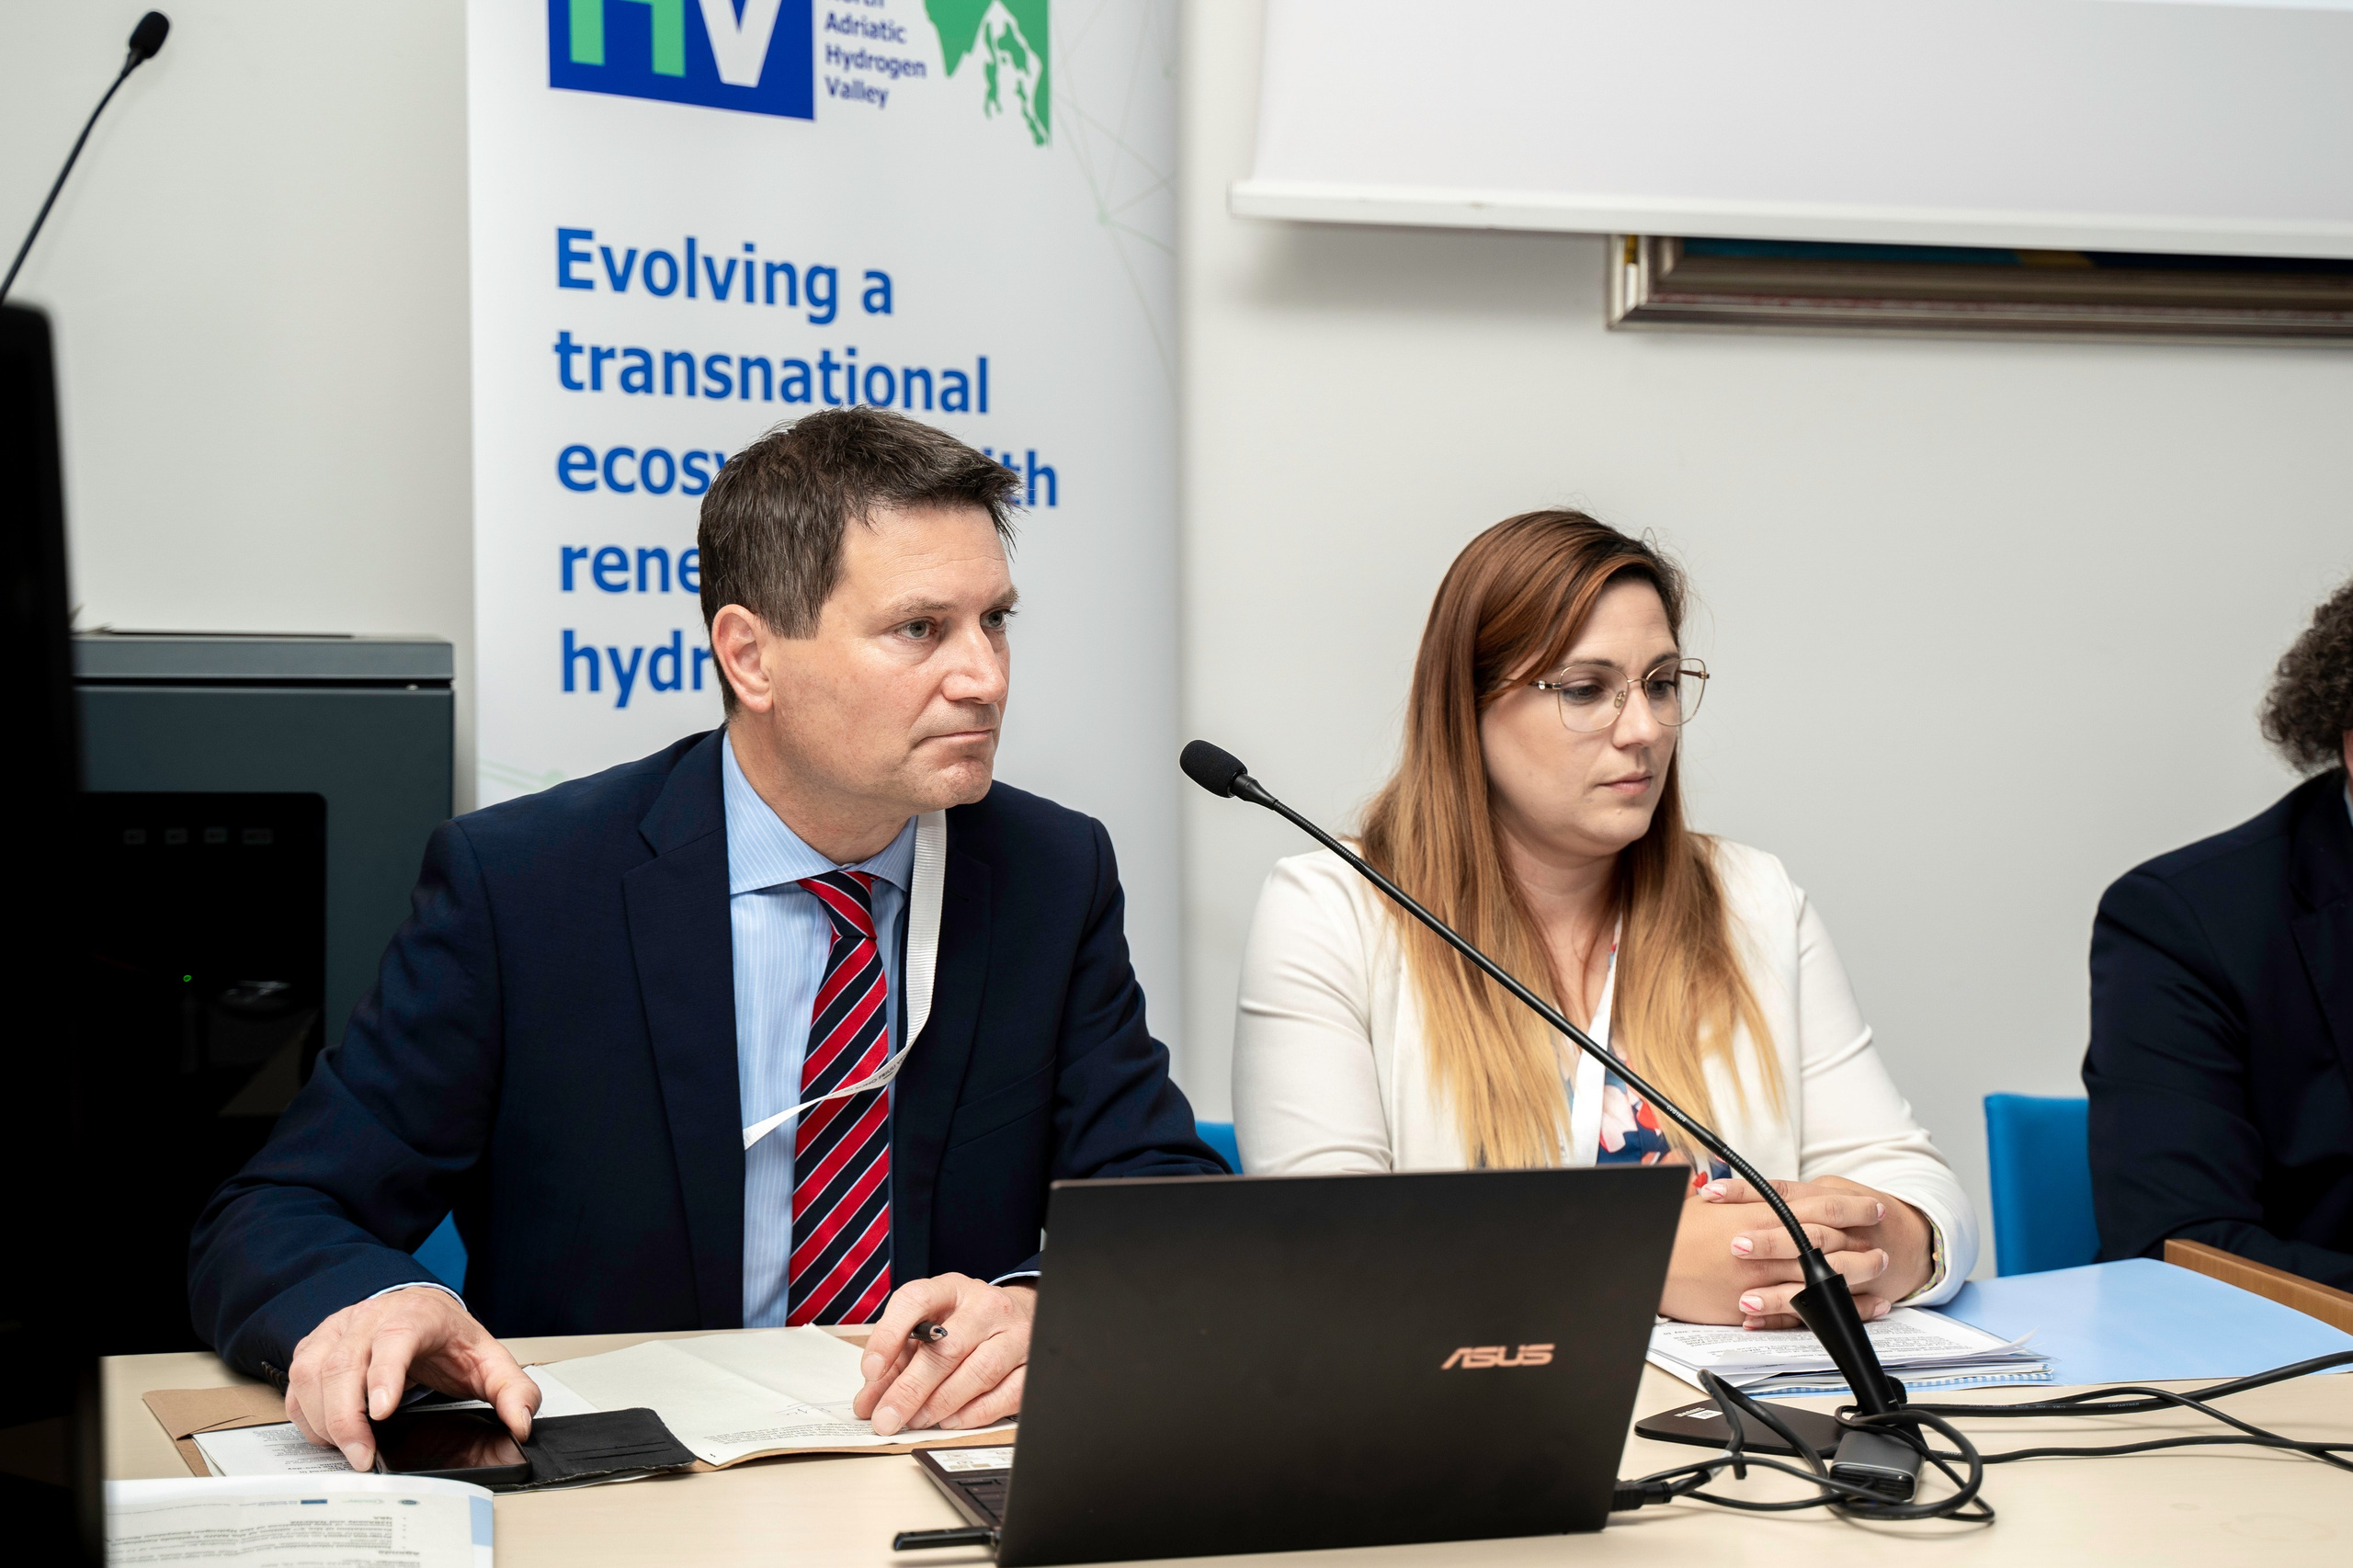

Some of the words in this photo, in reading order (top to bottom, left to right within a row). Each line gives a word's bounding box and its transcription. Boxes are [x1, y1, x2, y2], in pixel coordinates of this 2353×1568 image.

[825, 12, 906, 43] Adriatic
[825, 44, 927, 81] Hydrogen
[825, 77, 889, 108] Valley
[555, 226, 839, 325] Evolving
[860, 268, 894, 316] a
[552, 330, 990, 415] transnational
[1440, 1343, 1555, 1370] ASUS
